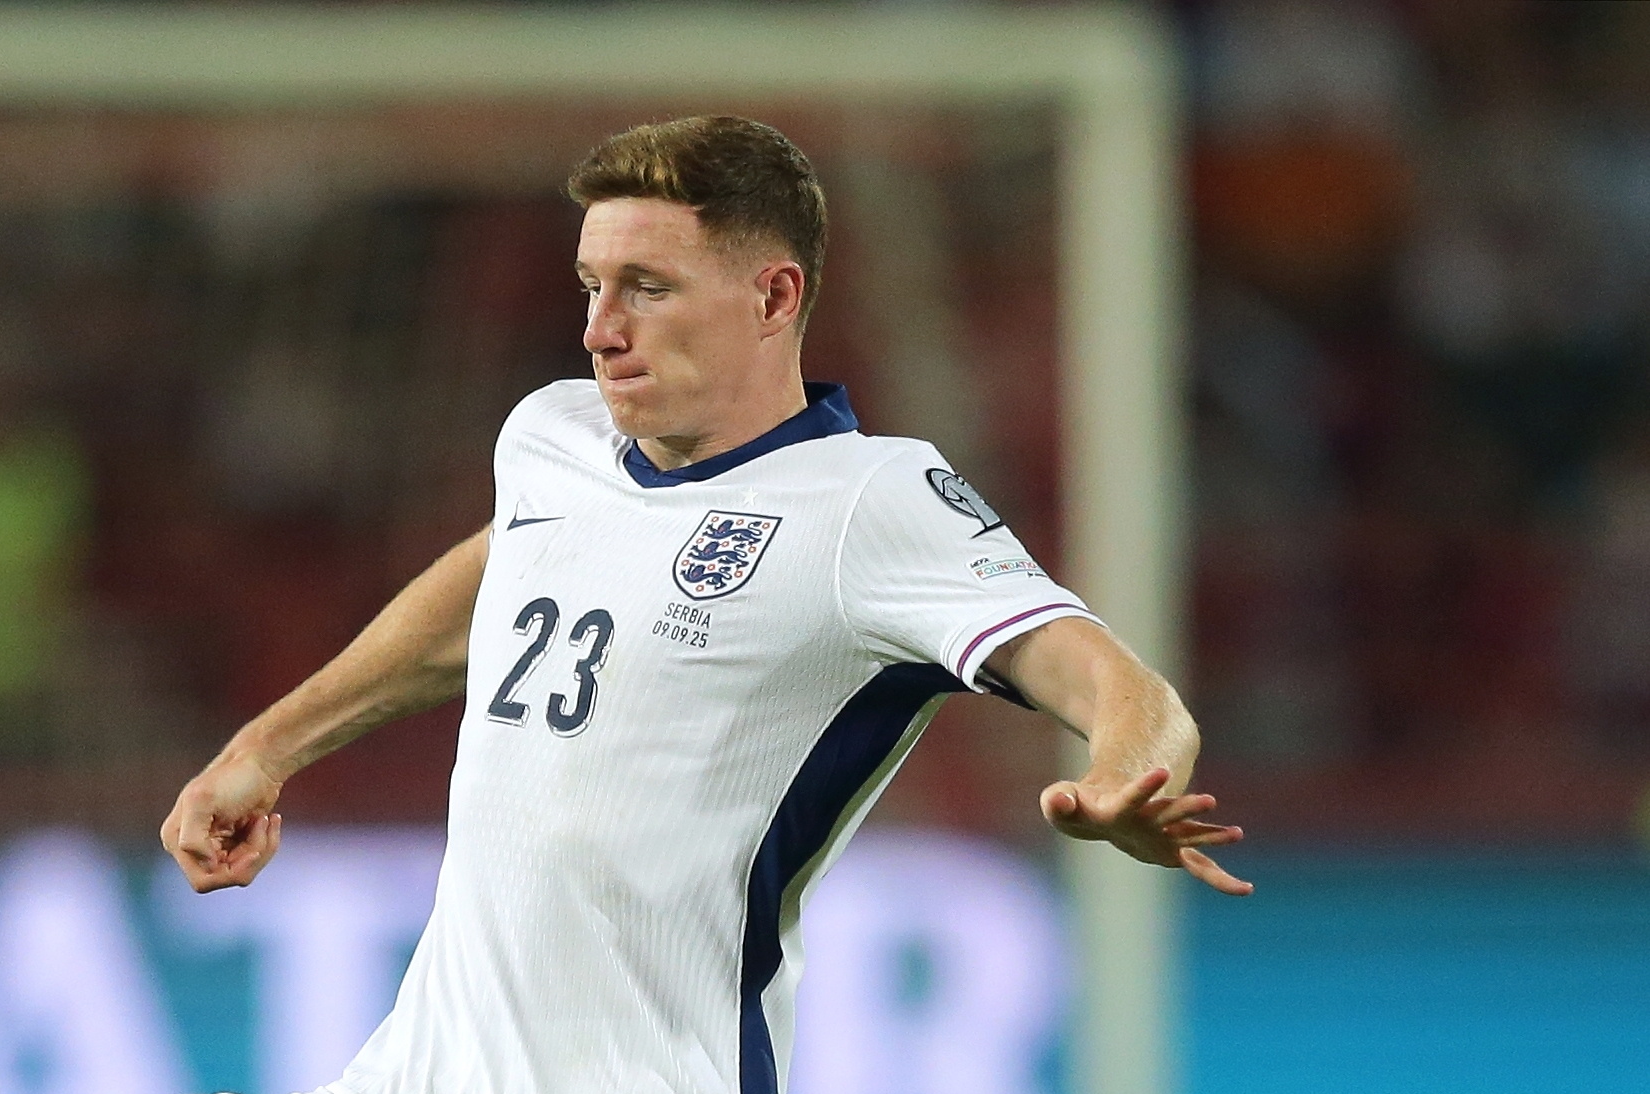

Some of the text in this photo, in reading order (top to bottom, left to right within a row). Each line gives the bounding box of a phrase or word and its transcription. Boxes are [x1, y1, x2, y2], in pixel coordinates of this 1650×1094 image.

[664, 602, 711, 629] SERBIA
[652, 620, 709, 648] 09.09.25
[488, 597, 615, 738] 23
